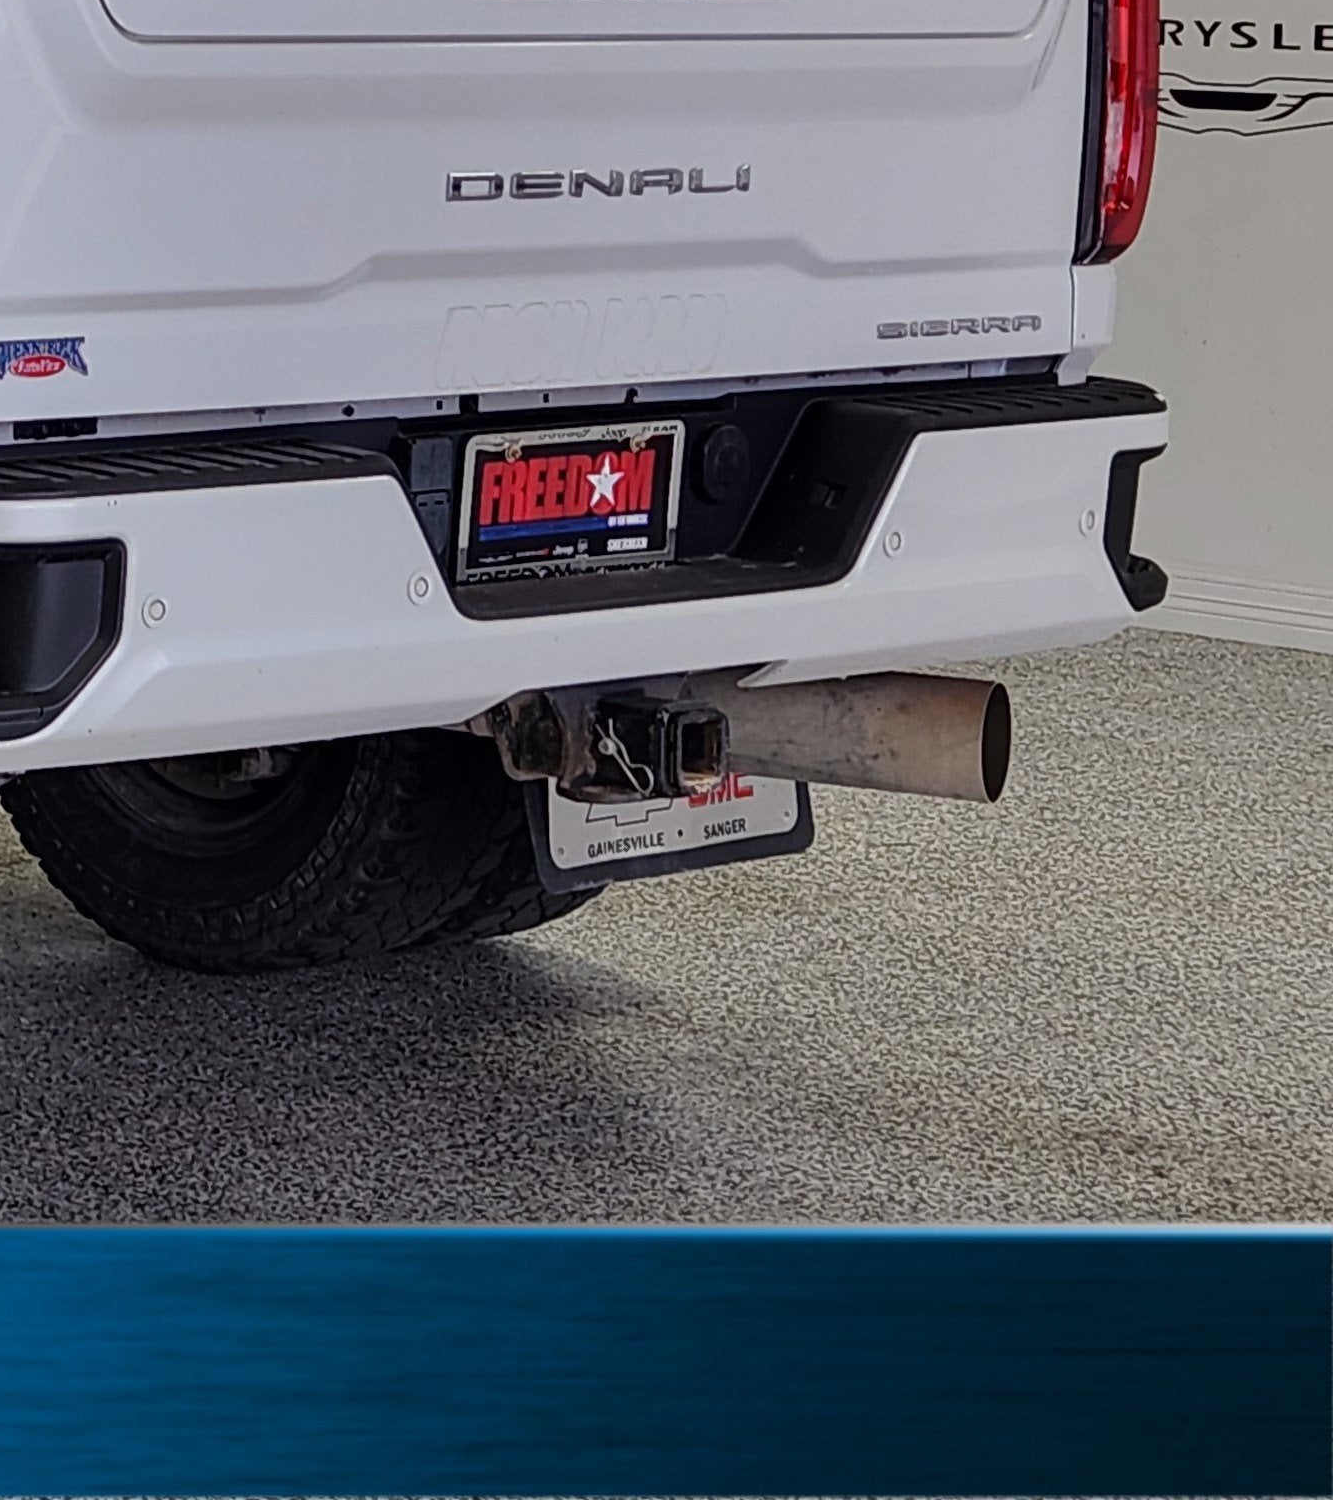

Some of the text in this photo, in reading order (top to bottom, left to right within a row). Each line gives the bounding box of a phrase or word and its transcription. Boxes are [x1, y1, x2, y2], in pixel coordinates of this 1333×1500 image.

[445, 164, 751, 202] DENALI
[876, 314, 1042, 340] SIERRA
[481, 451, 654, 525] FREEDOM
[587, 817, 746, 859] GAINESVILLE SANGER
